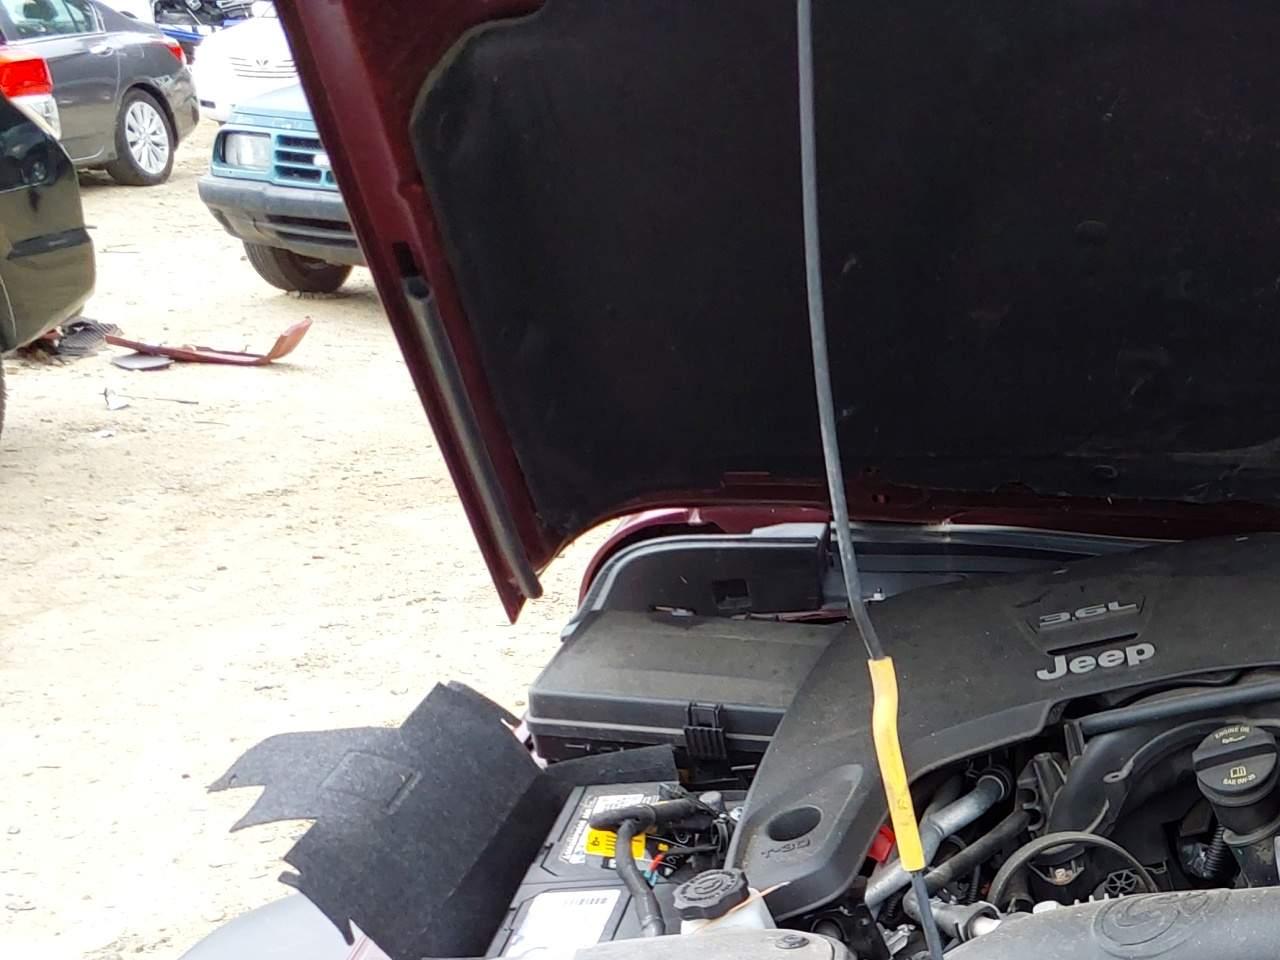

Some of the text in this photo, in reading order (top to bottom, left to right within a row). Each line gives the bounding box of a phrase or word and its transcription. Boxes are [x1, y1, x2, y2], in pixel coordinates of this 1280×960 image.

[1039, 601, 1137, 627] 3.6L
[1036, 642, 1155, 680] Jeep
[1214, 726, 1239, 740] ENGINE
